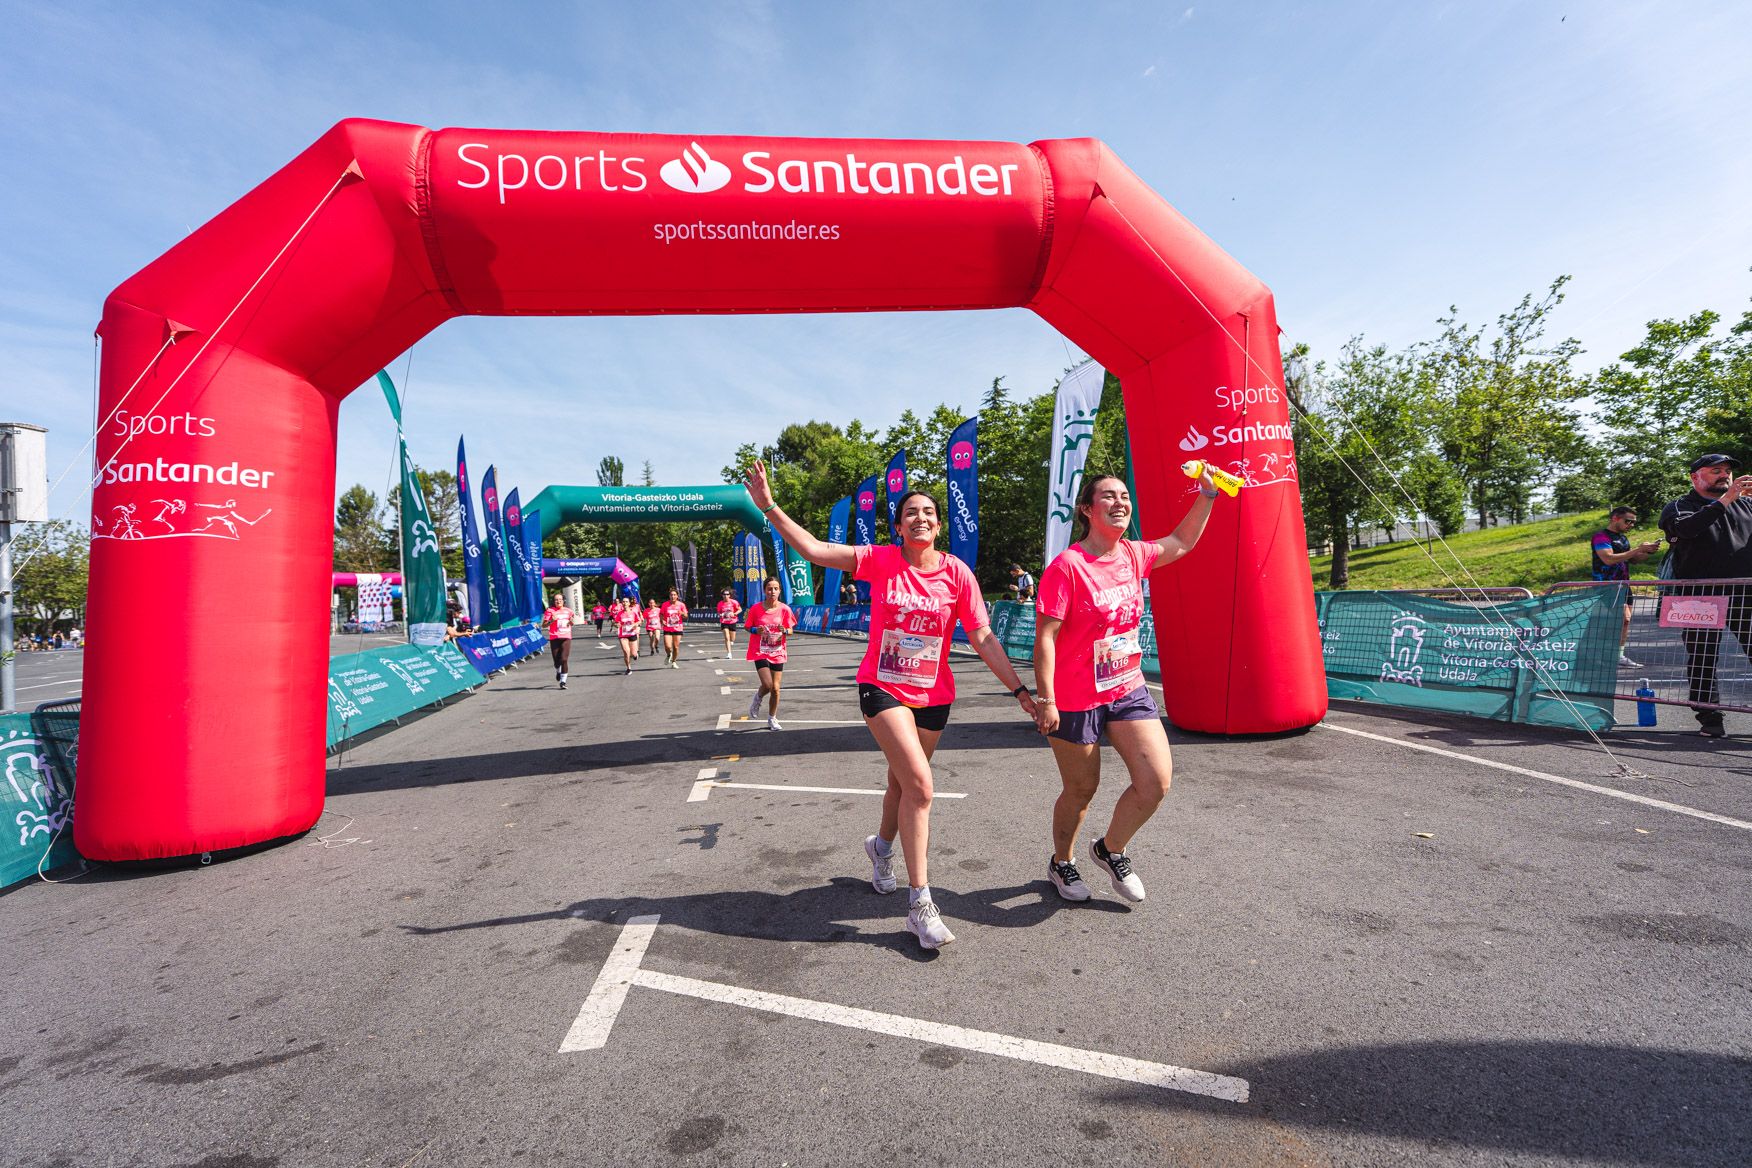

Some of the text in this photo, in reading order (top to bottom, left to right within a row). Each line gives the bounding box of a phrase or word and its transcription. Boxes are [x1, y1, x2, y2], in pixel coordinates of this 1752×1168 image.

[457, 143, 1018, 204] Sports Santander
[654, 219, 840, 244] sportssantander.es
[1215, 384, 1280, 411] Sports
[114, 410, 216, 441] Sports
[1212, 421, 1293, 446] Santand
[105, 457, 275, 489] Santander
[601, 493, 704, 502] Vitoria-Gasteizko Udala
[949, 480, 977, 533] octopus
[582, 503, 723, 514] Ayuntamiento de Vitoria-Gasteiz
[954, 516, 968, 542] energy
[1670, 613, 1714, 621] EVENTOS
[1443, 623, 1550, 637] Ayuntamiento
[1443, 637, 1577, 652] de Vitoria-Gasteiz
[898, 657, 921, 668] 016
[1112, 656, 1129, 669] 016
[1441, 653, 1569, 671] Vitoria-Gasteizko
[1440, 667, 1478, 681] Udala
